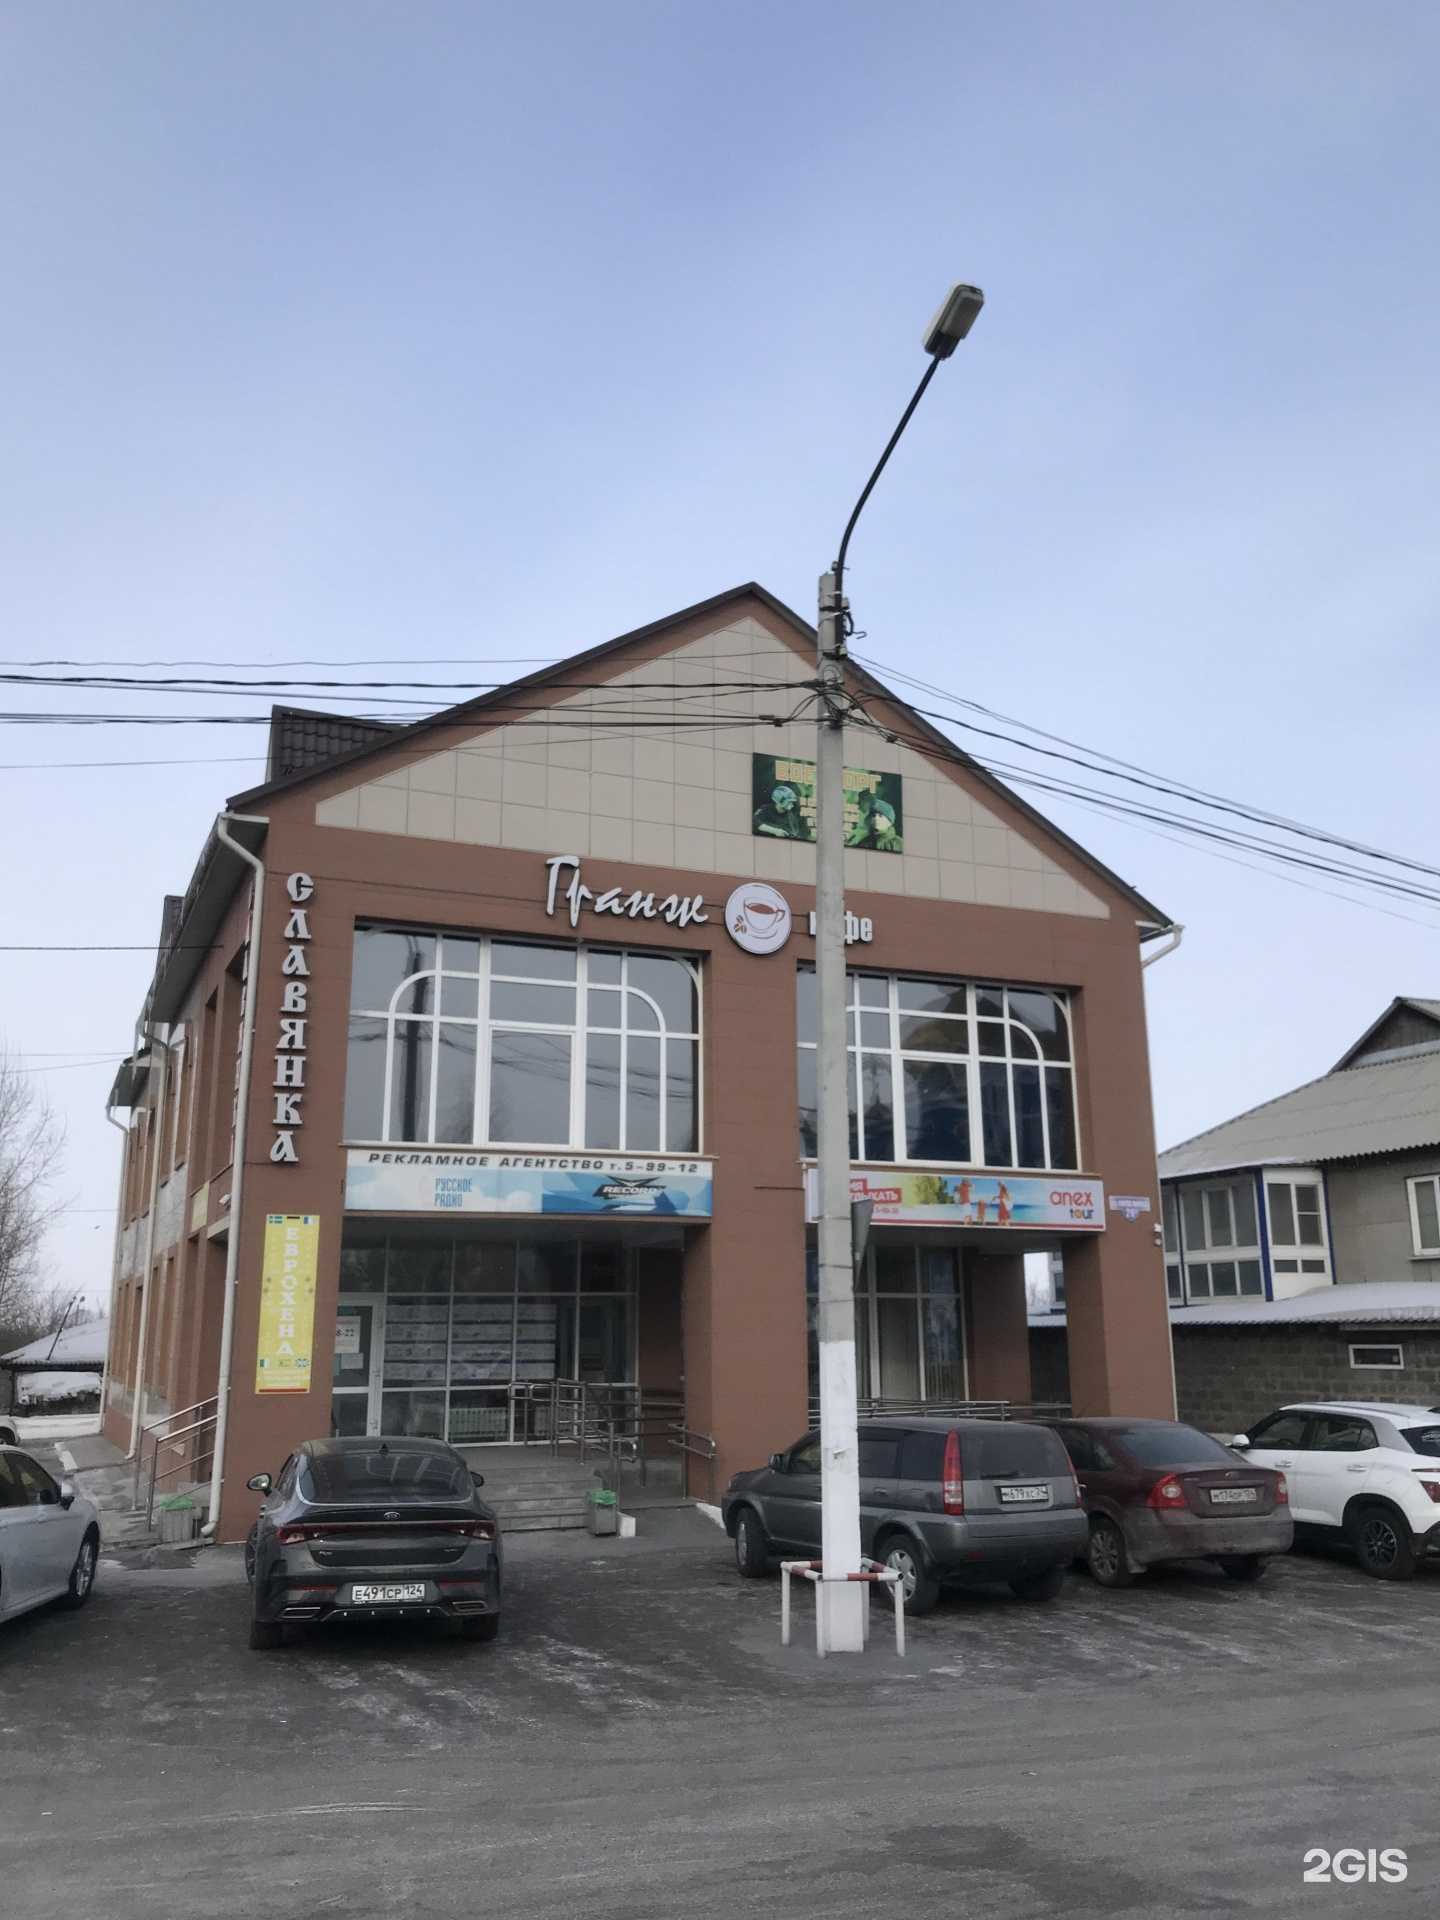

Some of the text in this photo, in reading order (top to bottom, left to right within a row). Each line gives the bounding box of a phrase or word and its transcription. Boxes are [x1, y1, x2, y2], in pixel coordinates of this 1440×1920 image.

[775, 760, 881, 794] ВОЕОРГ
[546, 855, 709, 928] Гранж
[810, 911, 873, 944] фе
[270, 872, 314, 1162] СЛАВЯНКА
[369, 1153, 489, 1167] РЕКЛАМНОЕ
[499, 1157, 603, 1170] АГЕНТСТВО
[435, 1178, 472, 1192] РУССКОЕ
[602, 1186, 657, 1195] RECORD
[434, 1193, 463, 1207] РАДИО
[1050, 1191, 1093, 1206] anex
[1070, 1208, 1094, 1219] tour
